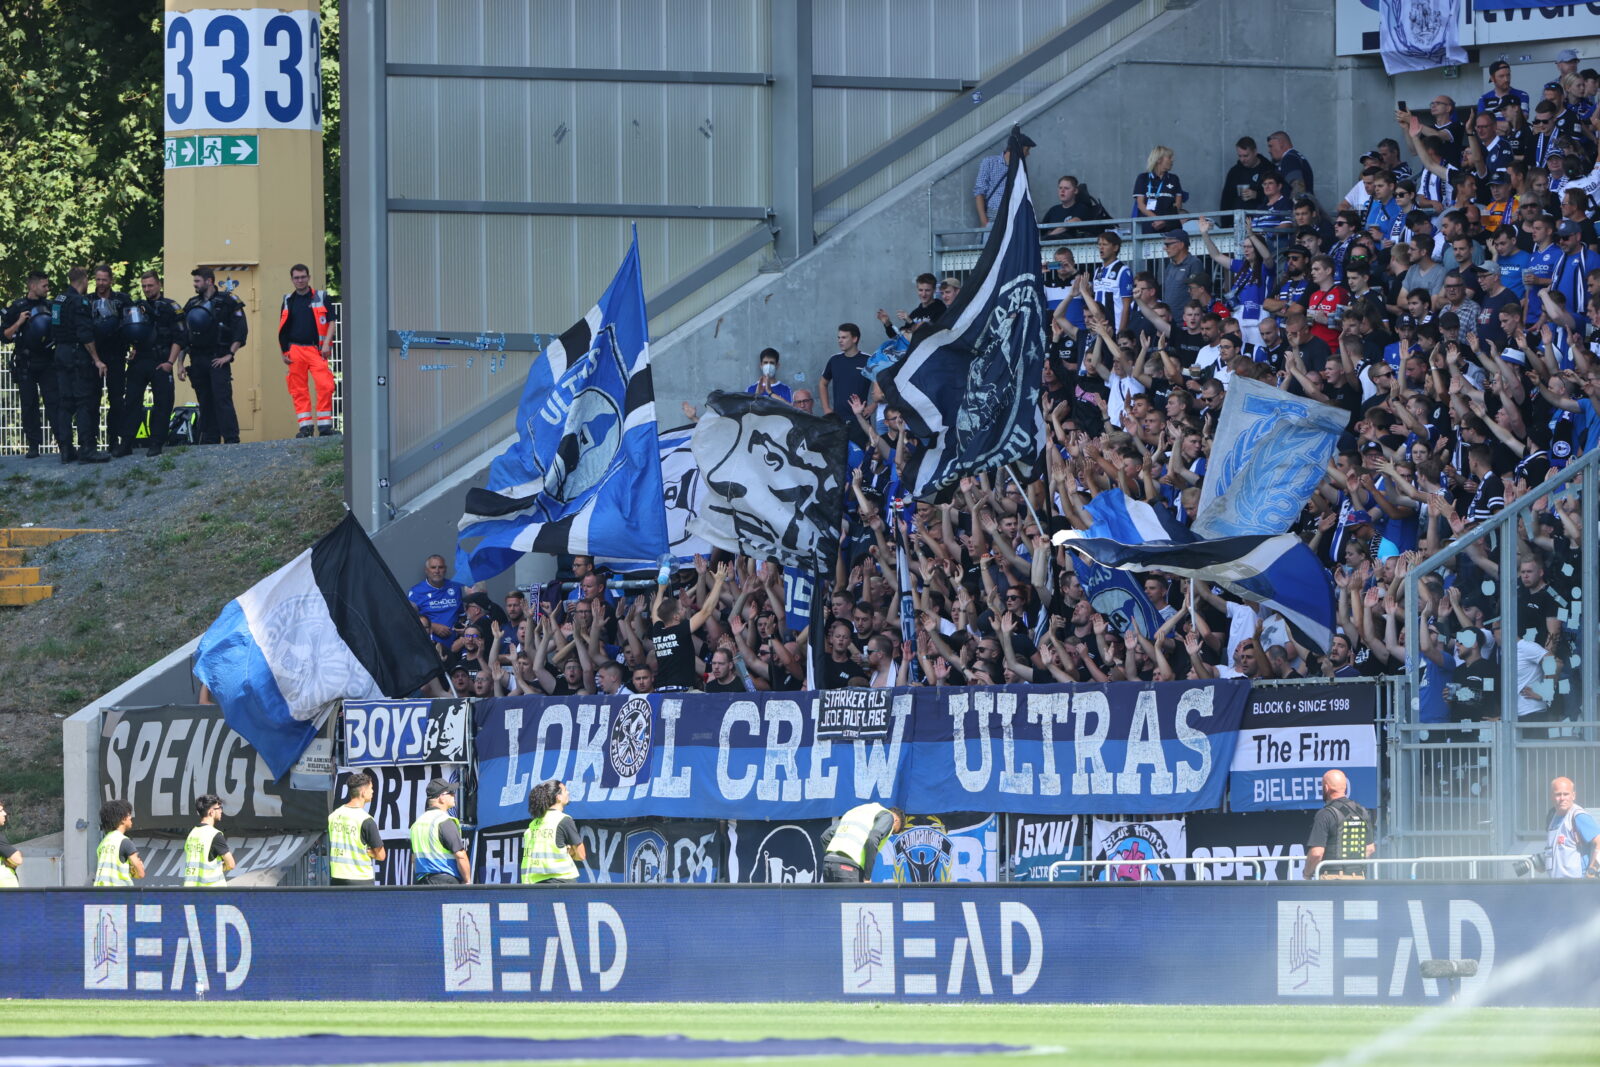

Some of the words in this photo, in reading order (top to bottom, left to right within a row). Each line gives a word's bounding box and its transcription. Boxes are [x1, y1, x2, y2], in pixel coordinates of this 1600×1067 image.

[867, 690, 887, 708] ALS
[1253, 701, 1284, 714] BLOCK
[1285, 700, 1292, 713] 6
[1298, 699, 1327, 713] SINCE
[1328, 698, 1350, 711] 1998
[820, 709, 842, 727] JEDE
[842, 708, 887, 727] AUFLAGE
[346, 706, 428, 762] BOYS
[499, 699, 692, 806] LOKL
[716, 693, 913, 801] CREW
[948, 685, 1215, 795] ULTRAS
[1252, 734, 1292, 764] The
[1298, 732, 1350, 762] Firm
[104, 719, 283, 818] SPENGE
